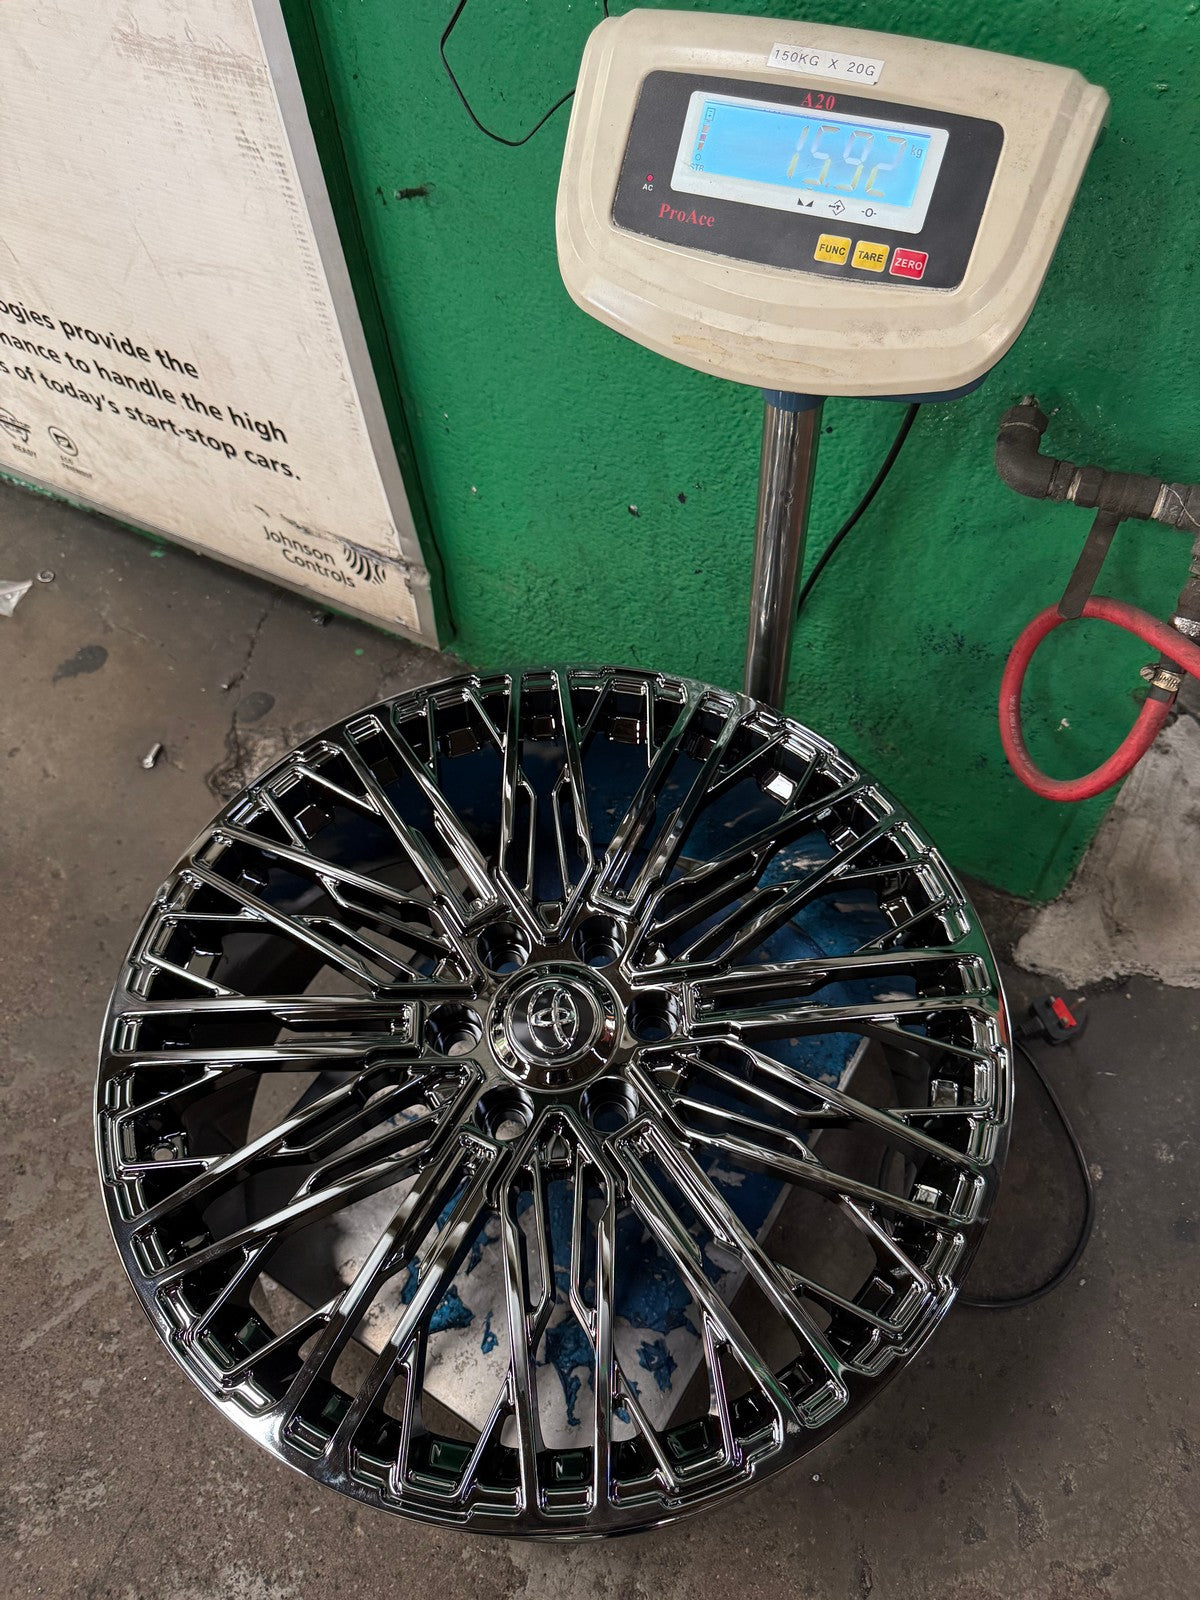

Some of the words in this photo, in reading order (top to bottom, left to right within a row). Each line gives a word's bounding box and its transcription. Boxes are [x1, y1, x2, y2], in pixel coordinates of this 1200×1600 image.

[774, 49, 820, 66] 150KG
[828, 58, 839, 70] X
[847, 62, 876, 77] 20G
[801, 92, 836, 111] A20
[787, 125, 907, 198] 15.92
[910, 144, 923, 159] kg
[642, 183, 654, 192] AC
[658, 203, 716, 228] ProAce
[819, 243, 846, 256] FUNC
[858, 250, 884, 263] TARE
[894, 257, 923, 271] ZERO
[58, 319, 151, 363] provide
[155, 349, 200, 379] the
[64, 351, 91, 374] to
[92, 359, 176, 404] handle
[181, 392, 224, 421] the
[227, 406, 288, 444] high
[14, 366, 36, 385] of
[40, 372, 120, 413] today's
[125, 404, 238, 459] start-stop
[244, 449, 302, 481] cars.
[263, 525, 336, 566] Johnson
[282, 548, 356, 588] Controls
